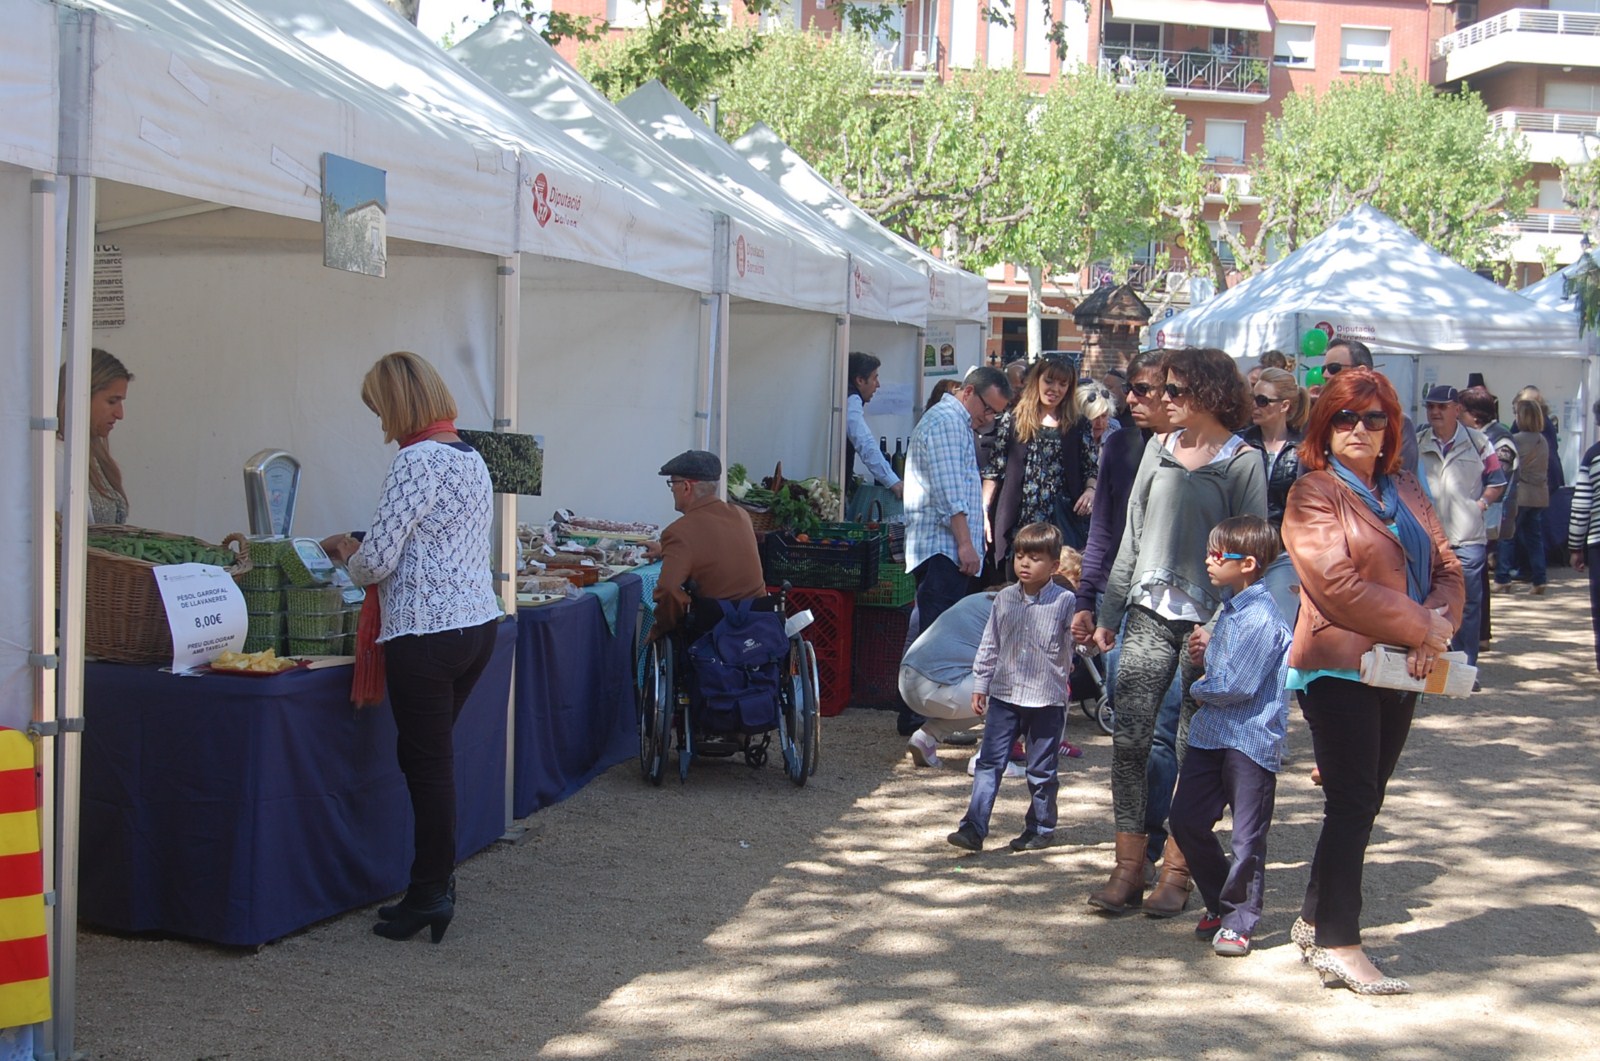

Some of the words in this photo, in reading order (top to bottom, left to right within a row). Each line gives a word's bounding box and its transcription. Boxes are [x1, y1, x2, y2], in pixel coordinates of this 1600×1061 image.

[549, 186, 581, 211] Diputació
[1336, 324, 1376, 334] Diputació
[197, 588, 228, 598] GARROFAL
[190, 595, 228, 607] LLAVANERES
[195, 613, 222, 629] 8,00€
[187, 641, 202, 649] PREU
